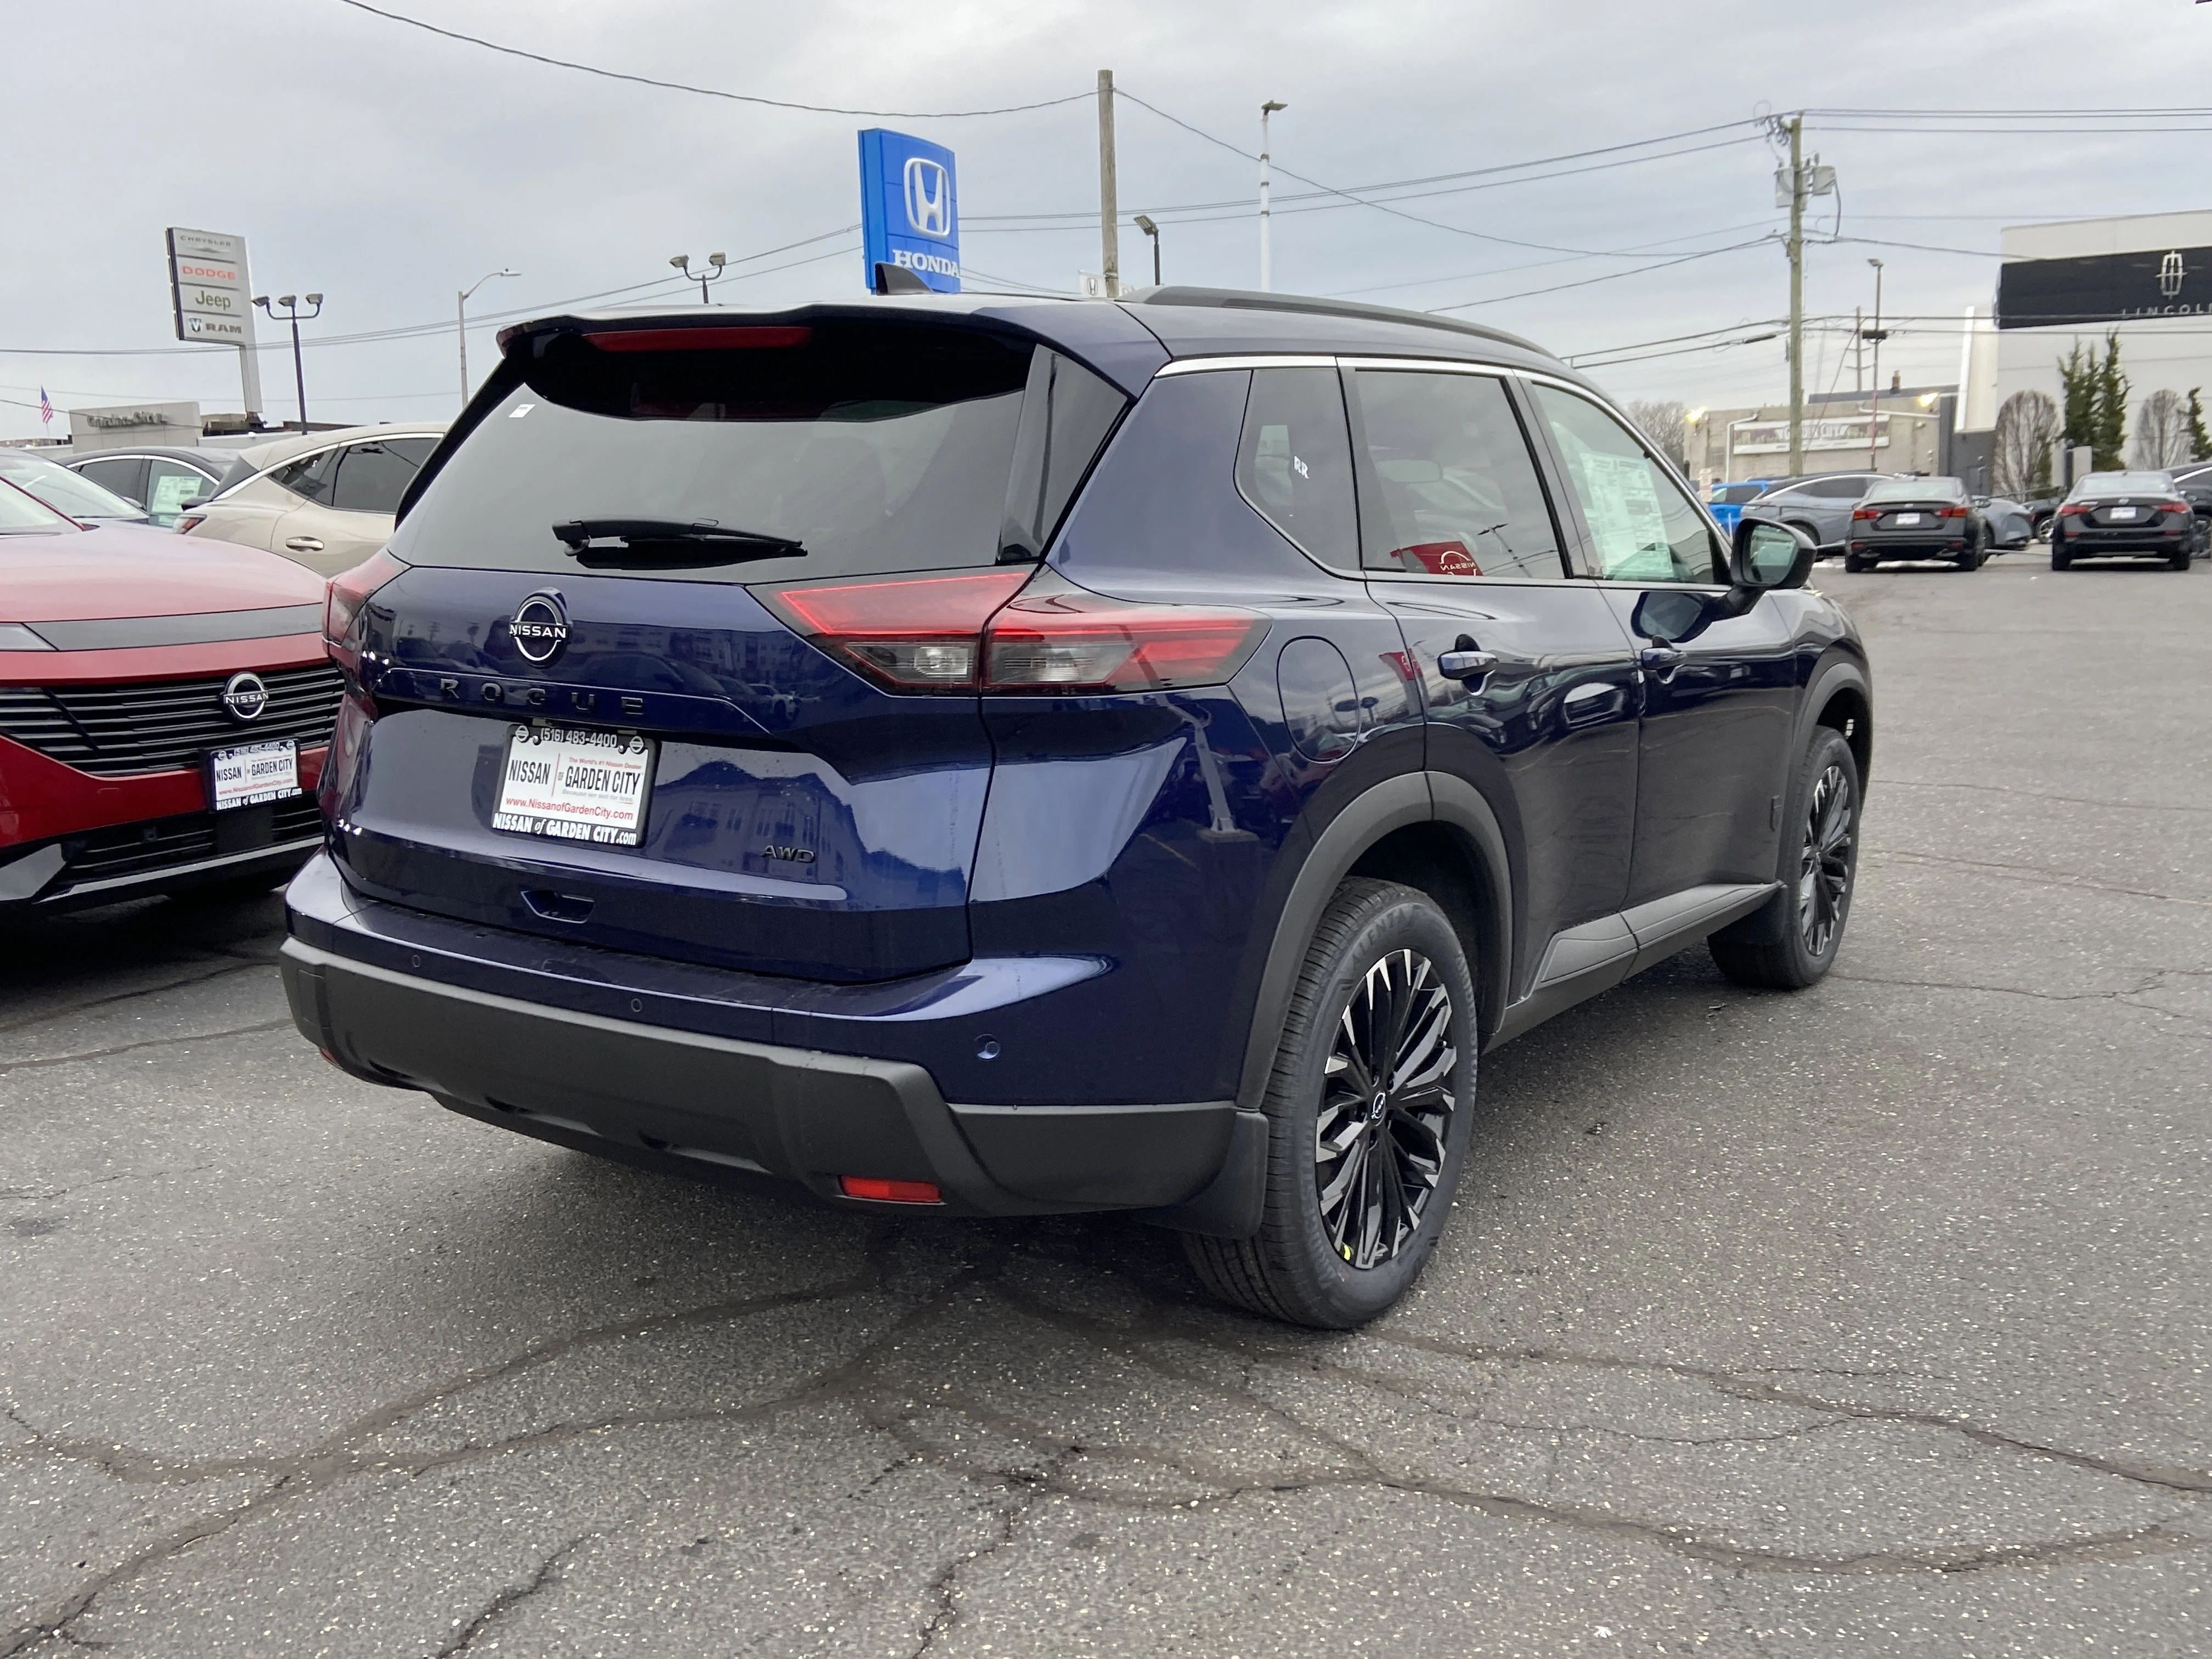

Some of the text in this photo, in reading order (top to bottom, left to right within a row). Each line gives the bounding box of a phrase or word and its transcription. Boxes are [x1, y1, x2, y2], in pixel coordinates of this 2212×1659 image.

[180, 235, 230, 246] CHRYSLER
[183, 266, 235, 280] DODGE
[893, 249, 960, 278] HONDA
[195, 290, 230, 311] Jeep
[206, 323, 242, 334] RAM
[509, 624, 566, 639] NISSAN
[225, 692, 269, 704] NISSAN
[440, 678, 644, 715] ROGUE
[541, 727, 617, 748] (516) 483-4400
[216, 766, 242, 782] NISSAN
[251, 760, 277, 776] GARDEN
[279, 758, 292, 771] CITY
[508, 759, 551, 785] NISSAN
[565, 765, 611, 792] GARDEN
[612, 770, 641, 795] CITY
[216, 797, 242, 811] NISSAN
[250, 791, 276, 804] GARDEN
[506, 797, 634, 820] www.NissanofGardenCity.com
[493, 812, 637, 845] NISSAN of GARDEN CITY.com
[761, 845, 815, 863] AWD
